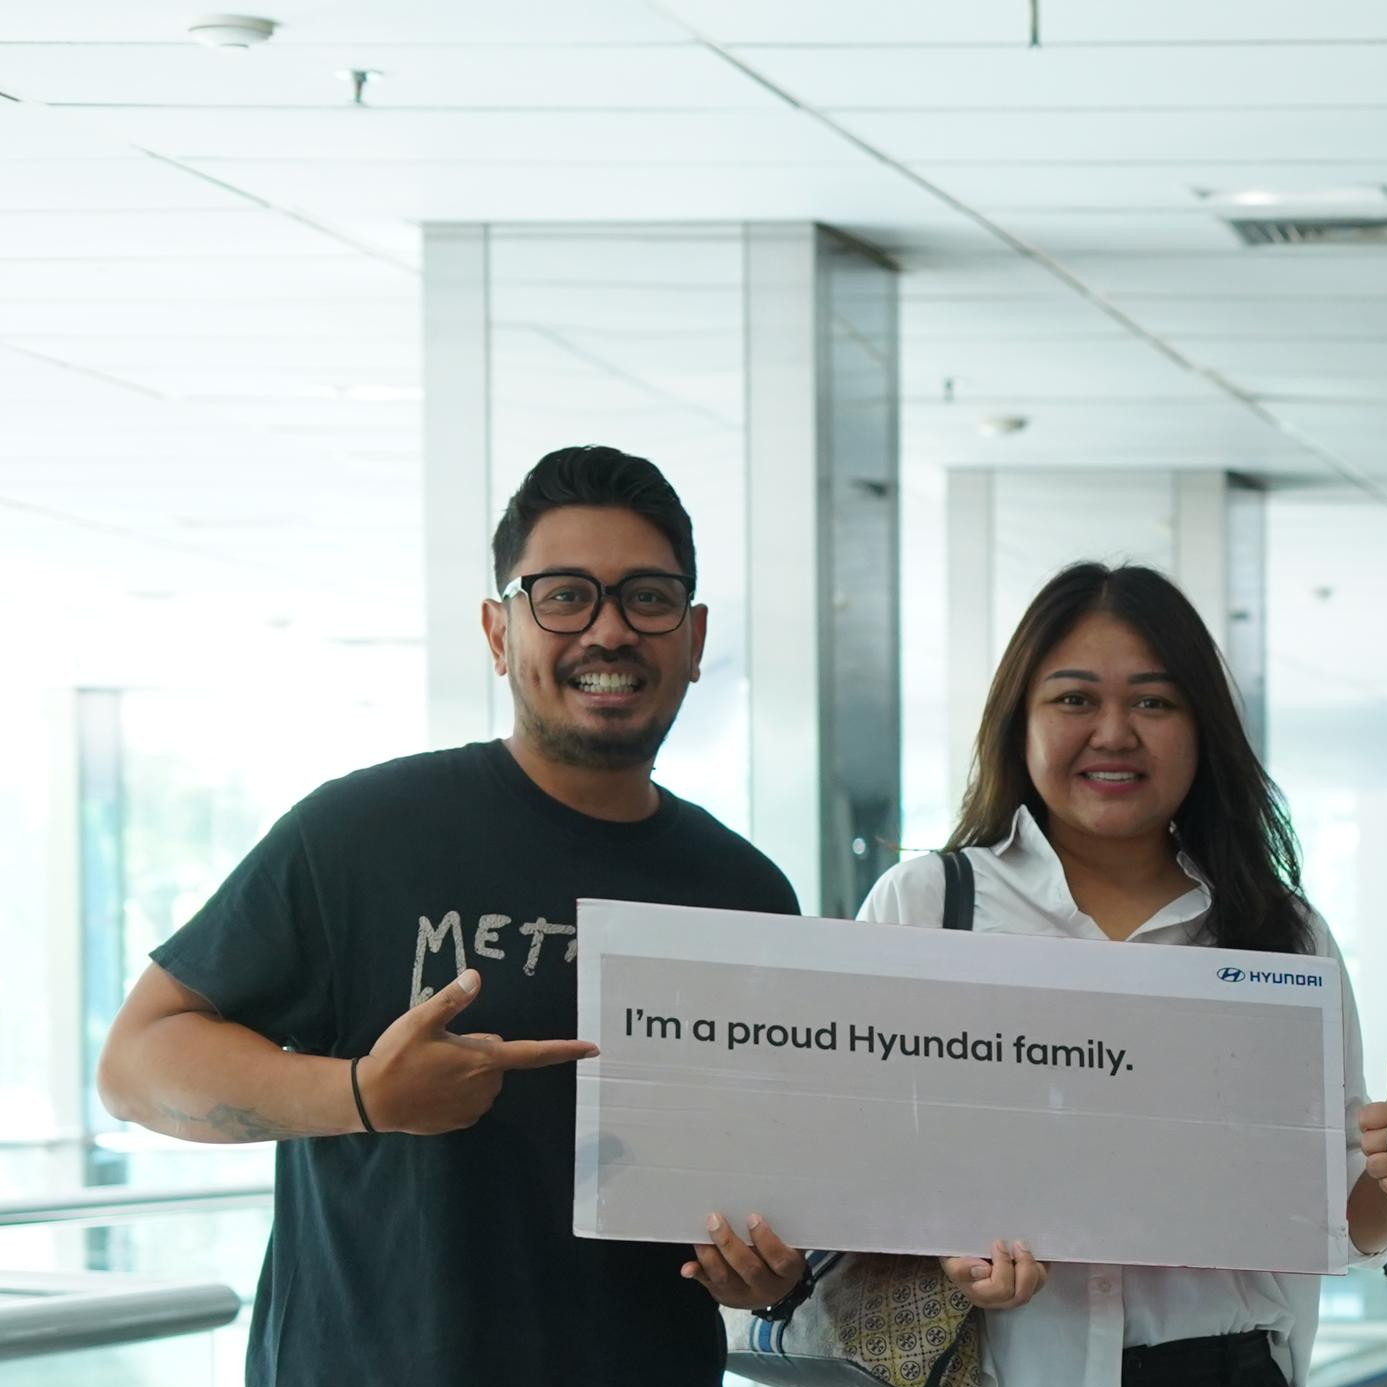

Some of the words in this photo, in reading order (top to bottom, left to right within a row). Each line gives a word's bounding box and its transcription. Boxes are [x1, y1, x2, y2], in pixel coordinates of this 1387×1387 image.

[409, 910, 577, 1010] MET
[1249, 970, 1323, 987] HYUNDAI
[692, 1019, 716, 1042] a
[727, 1021, 837, 1051] proud
[849, 1024, 1003, 1063] Hyundai
[1012, 1034, 1134, 1077] family.
